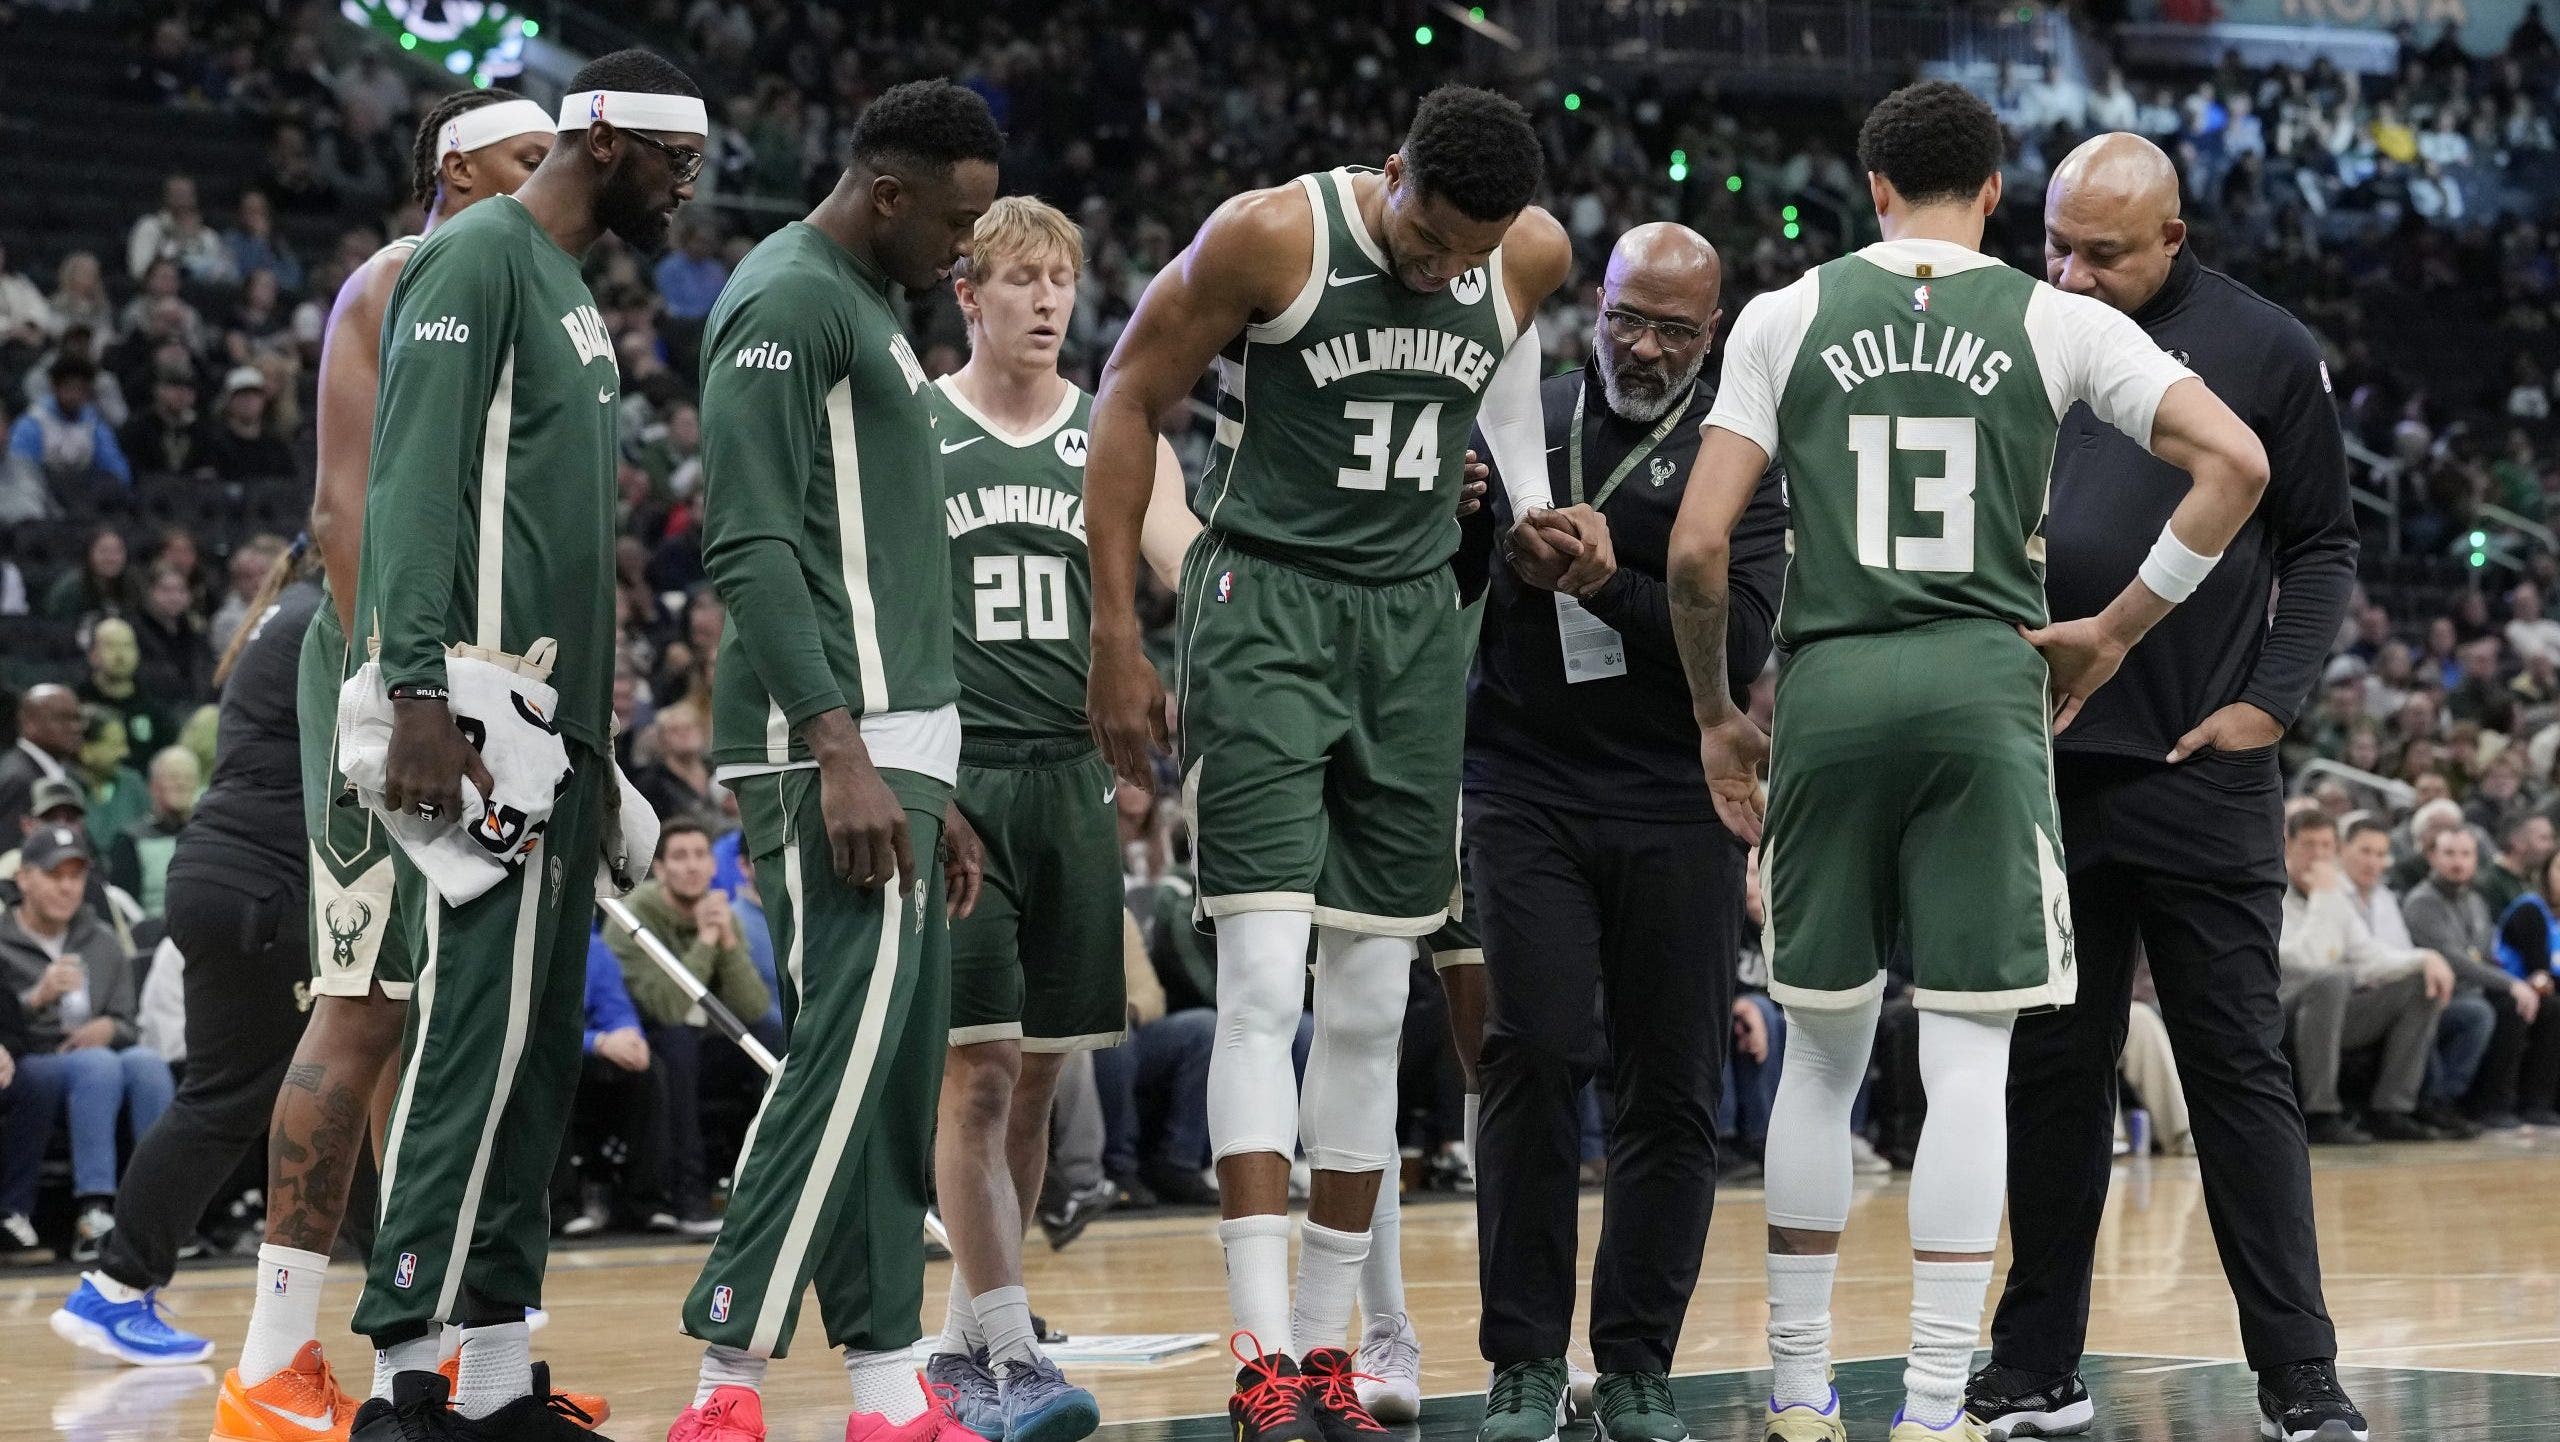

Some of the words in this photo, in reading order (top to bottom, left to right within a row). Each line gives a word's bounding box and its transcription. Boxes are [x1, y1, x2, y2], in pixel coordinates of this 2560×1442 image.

[415, 316, 470, 344] wilo
[735, 341, 792, 371] wilo
[1300, 328, 1496, 394] MILWAUKEE
[1820, 323, 2013, 396] ROLLINS
[1337, 401, 1444, 492] 34
[1849, 415, 1977, 573] 13
[974, 555, 1070, 641] 20
[416, 688, 437, 698] True
